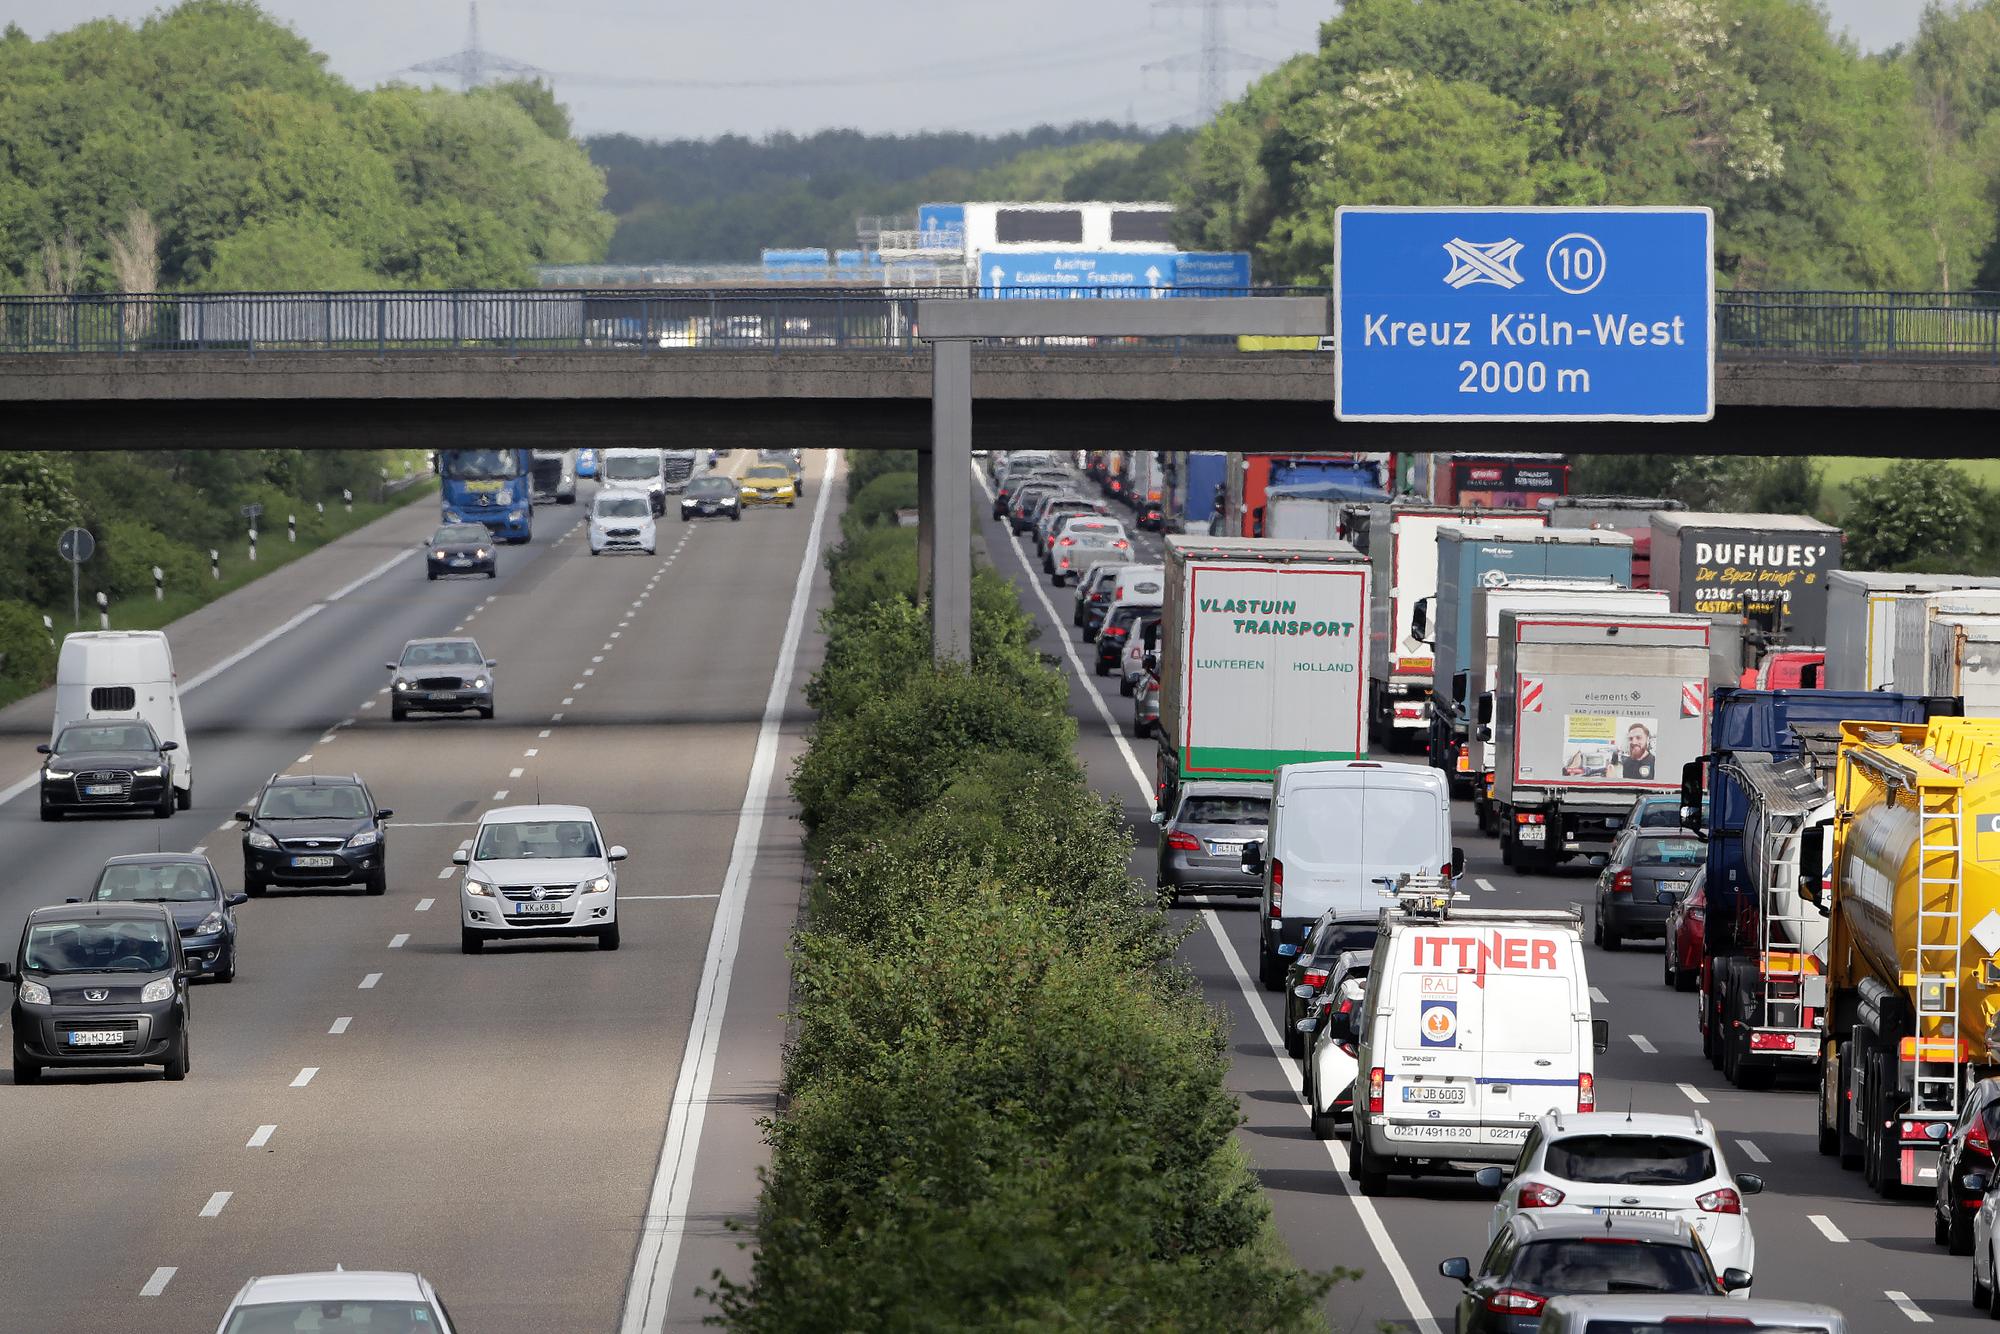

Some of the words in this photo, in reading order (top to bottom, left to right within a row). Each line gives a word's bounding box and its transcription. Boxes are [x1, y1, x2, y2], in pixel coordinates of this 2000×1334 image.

[1558, 248, 1594, 281] 10
[1364, 313, 1471, 347] Kreuz
[1490, 313, 1685, 347] Köln-West
[1458, 360, 1546, 394] 2000
[1557, 368, 1590, 394] m
[1696, 567, 1717, 581] Der
[1720, 567, 1757, 585] Spezi
[1758, 569, 1796, 587] bringt
[1695, 587, 1734, 601] 02305
[1199, 599, 1296, 614] VLASTUIN
[1233, 619, 1355, 637] TRANSPORT
[1196, 659, 1265, 670] LUNTEREN
[1293, 662, 1354, 673] HOLLAND
[1584, 692, 1628, 701] elements
[1413, 930, 1557, 989] ITTNER
[1424, 978, 1454, 991] RAL
[1409, 1088, 1416, 1098] K
[1423, 1089, 1436, 1099] JB
[1439, 1089, 1464, 1100] 6003
[1518, 1112, 1537, 1122] Fax
